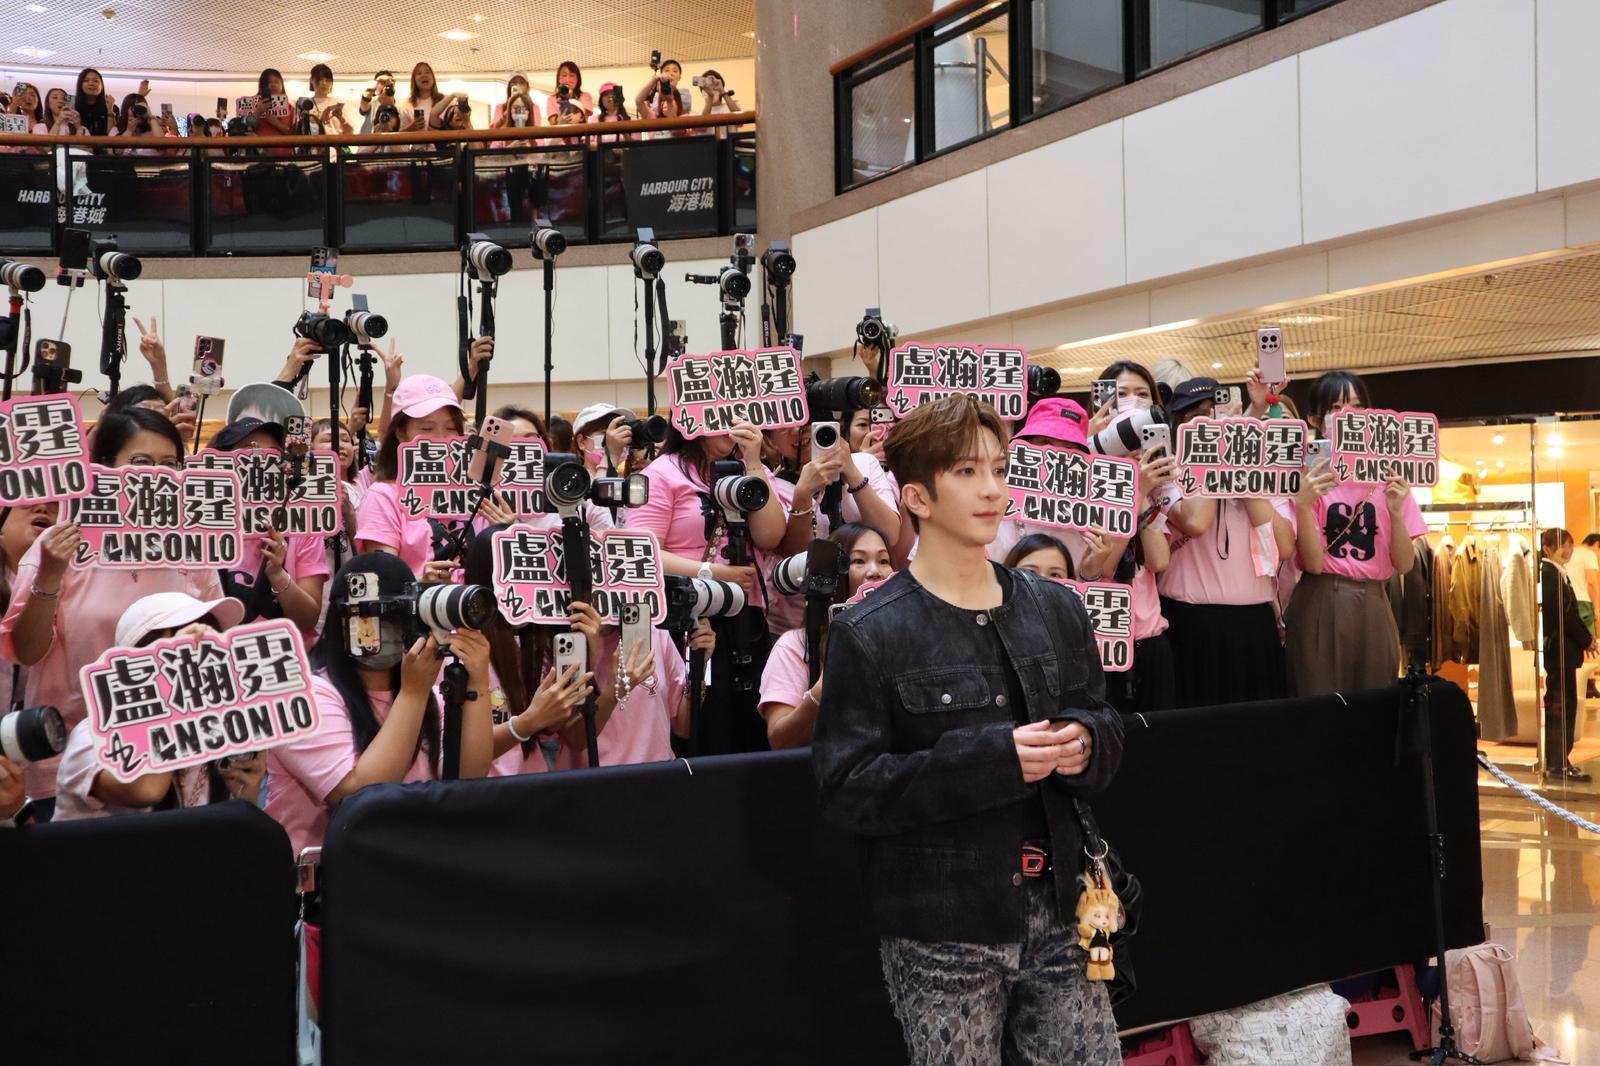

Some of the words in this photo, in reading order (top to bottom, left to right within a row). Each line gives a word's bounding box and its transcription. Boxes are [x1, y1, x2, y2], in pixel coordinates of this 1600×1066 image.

[640, 179, 688, 196] HARBOUR
[691, 177, 714, 191] CITY
[667, 191, 714, 212] 海港城
[672, 352, 801, 404] 盧瀚霆
[894, 348, 1023, 389] 盧瀚霆
[703, 400, 780, 431] ANSON
[781, 398, 804, 423] LO
[1000, 394, 1022, 416] LO
[1182, 424, 1302, 466] 盧瀚霆
[1337, 413, 1436, 457] 盧瀚霆
[50, 461, 86, 496] LO
[187, 455, 338, 502] 瀚霆
[1007, 446, 1134, 506] 盧瀚霆
[1205, 470, 1276, 493] ANSON
[1280, 471, 1300, 494] LO
[1418, 461, 1435, 484] LO
[70, 473, 235, 528] 盧瀚霆
[431, 489, 516, 514] ANSN
[521, 490, 544, 514] LO
[1023, 495, 1104, 527] ANSON
[1109, 508, 1131, 534] LO
[242, 506, 304, 534] NSON
[311, 505, 336, 533] LO
[103, 532, 202, 563] ANSON
[208, 533, 235, 563] LO
[534, 589, 627, 618] ANON
[1103, 640, 1128, 667] LO
[95, 629, 307, 730] 盧瀚霆
[150, 704, 274, 762] ANSON
[278, 696, 313, 733] LO
